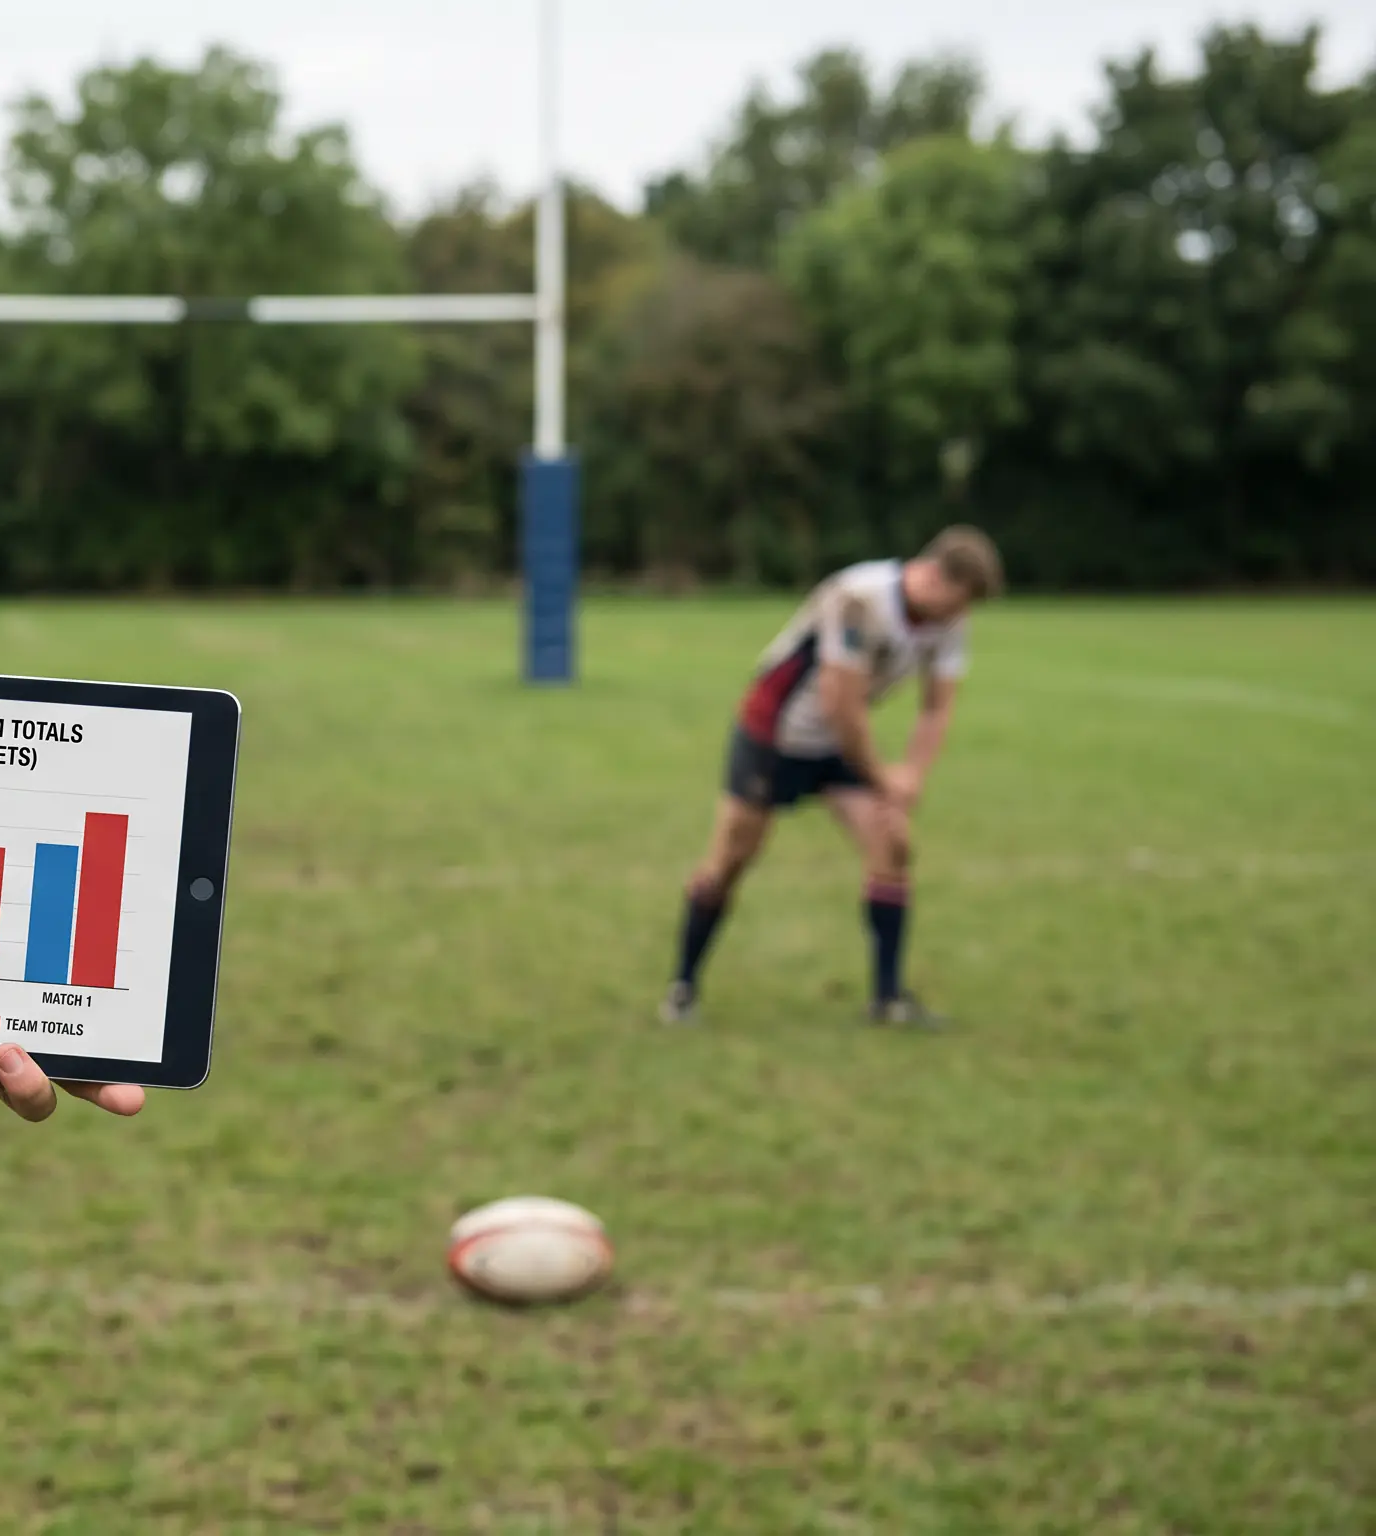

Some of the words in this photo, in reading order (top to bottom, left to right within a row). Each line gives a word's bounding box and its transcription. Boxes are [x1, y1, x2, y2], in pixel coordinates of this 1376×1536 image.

[11, 719, 83, 743] TOTALS
[42, 992, 82, 1007] MATCH
[86, 996, 92, 1007] 1
[5, 1018, 38, 1033] TEAM
[41, 1021, 84, 1036] TOTALS
